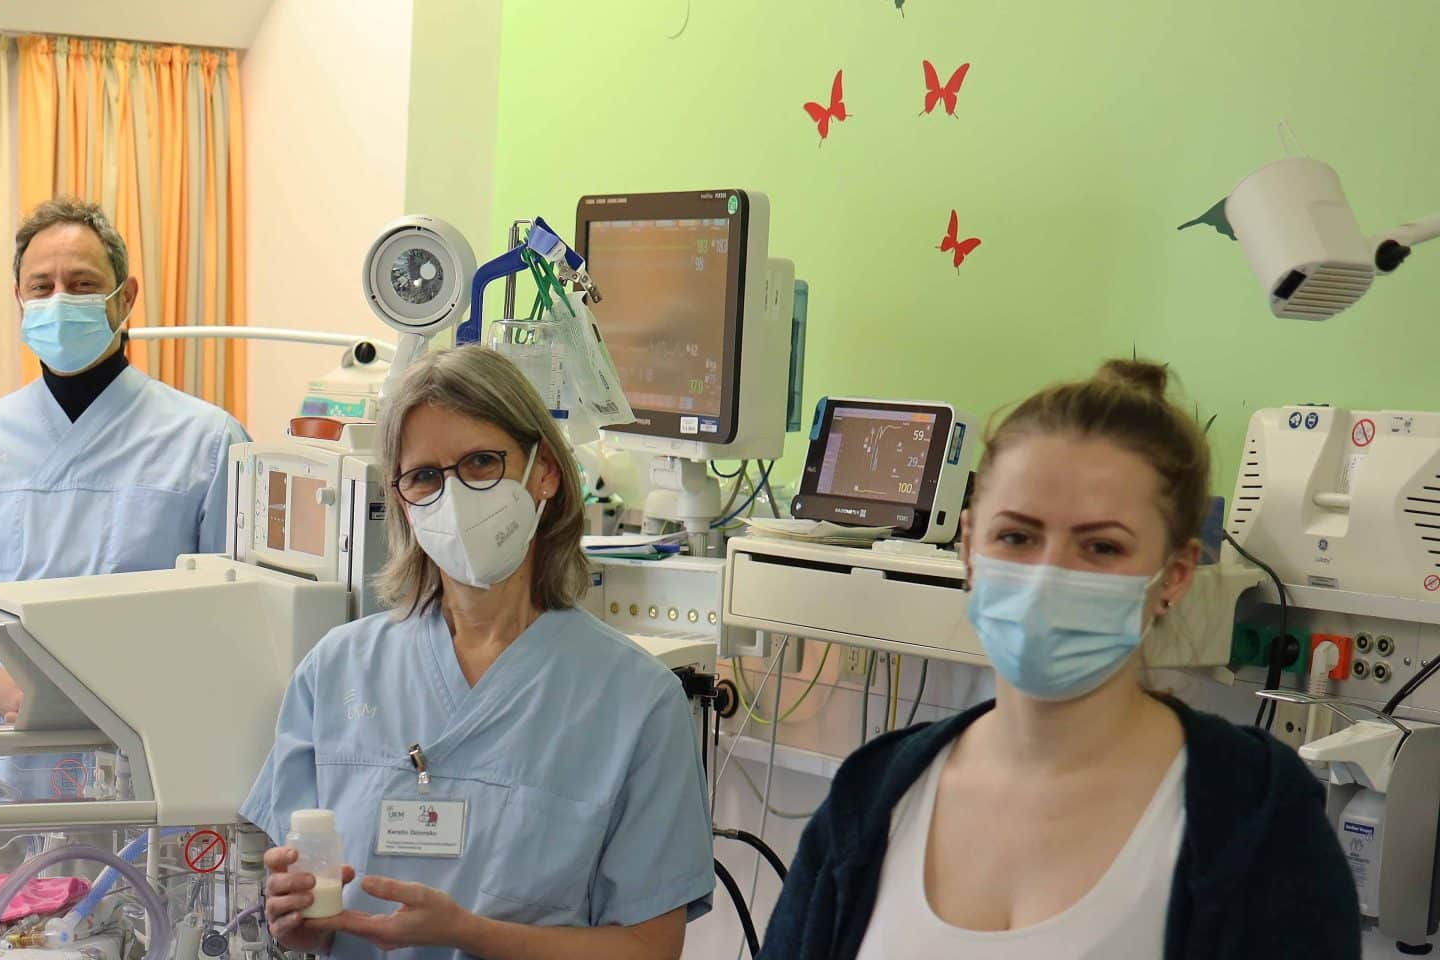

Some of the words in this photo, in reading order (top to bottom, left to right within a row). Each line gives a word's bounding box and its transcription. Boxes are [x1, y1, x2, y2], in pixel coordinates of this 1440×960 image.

[913, 430, 924, 441] 59
[907, 456, 918, 468] 29
[898, 482, 913, 494] 100
